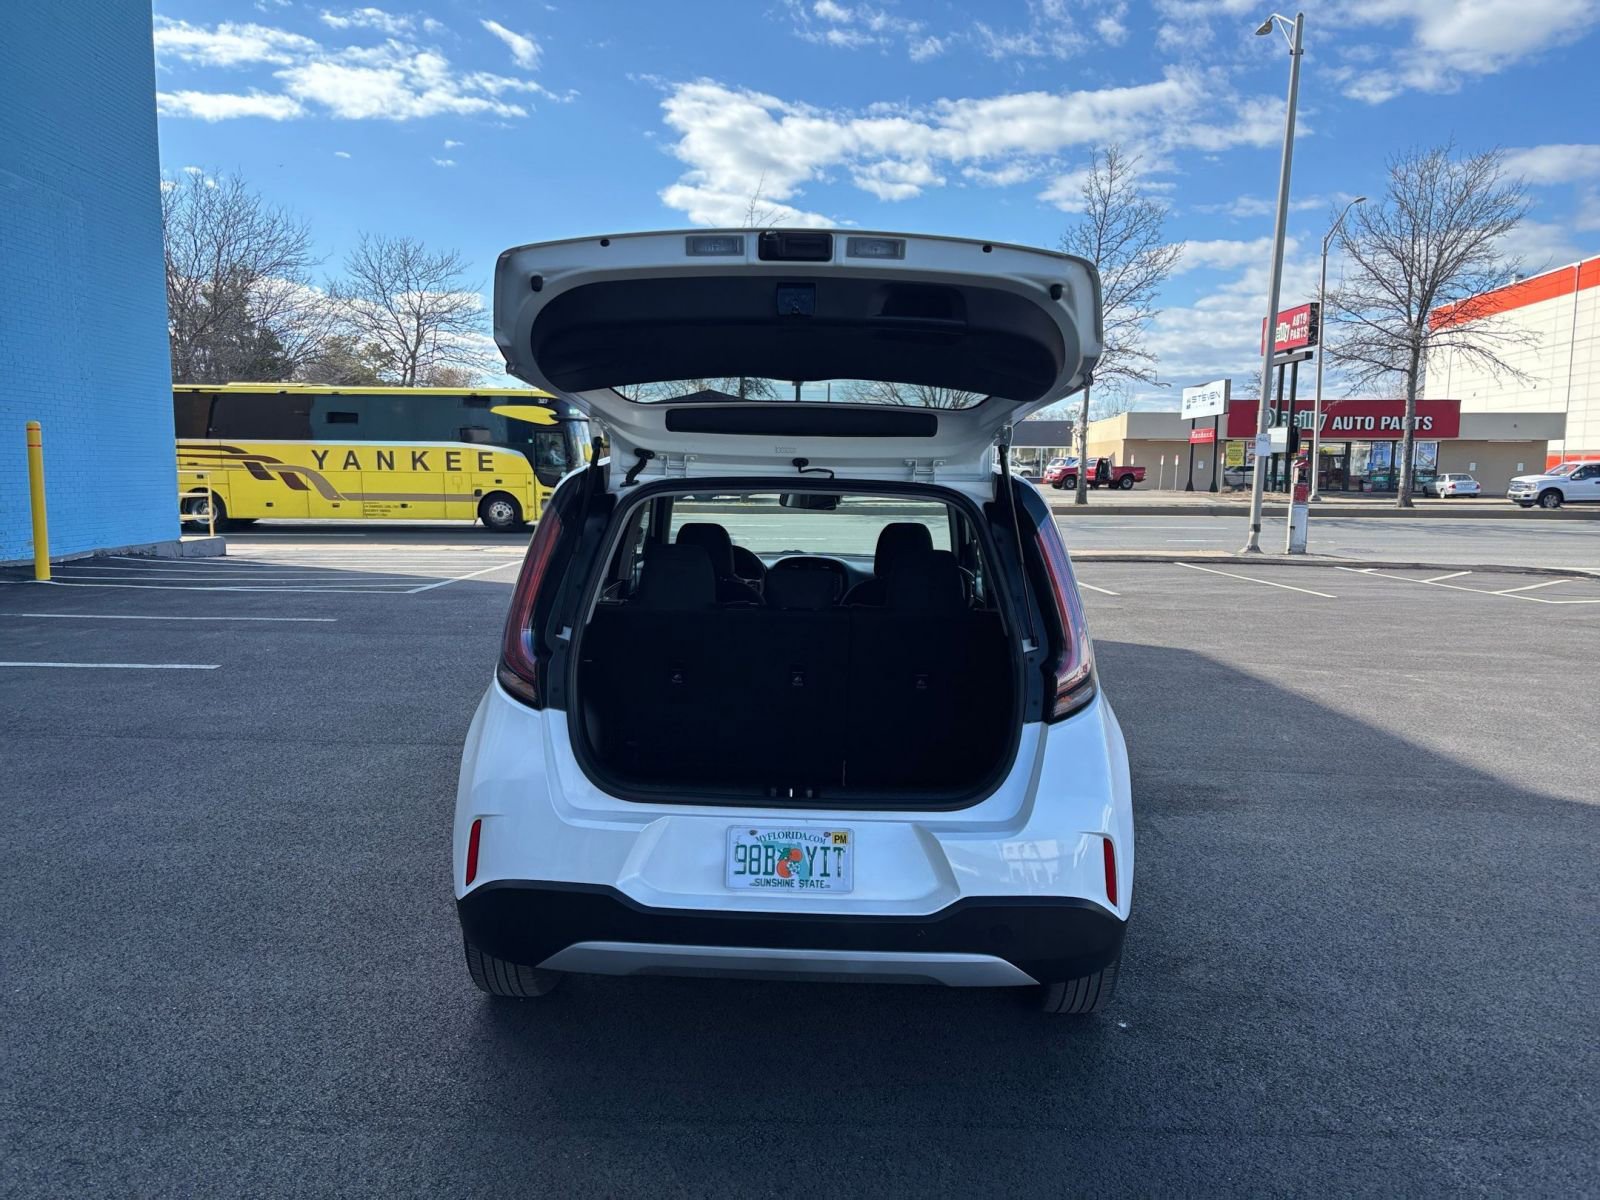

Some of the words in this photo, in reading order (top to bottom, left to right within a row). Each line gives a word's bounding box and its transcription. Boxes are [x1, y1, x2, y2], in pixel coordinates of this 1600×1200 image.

[1292, 311, 1307, 327] AUTO
[1290, 325, 1308, 341] PARTS
[1257, 408, 1328, 431] Reilly
[1332, 416, 1375, 430] AUTO
[312, 450, 494, 472] YANKEE
[755, 831, 826, 844] MYFLORIDA.COM
[834, 835, 846, 844] PM
[734, 844, 775, 875] 98B
[806, 846, 846, 877] YIT
[755, 878, 795, 887] SUNSHINE
[799, 879, 825, 888] STATE
